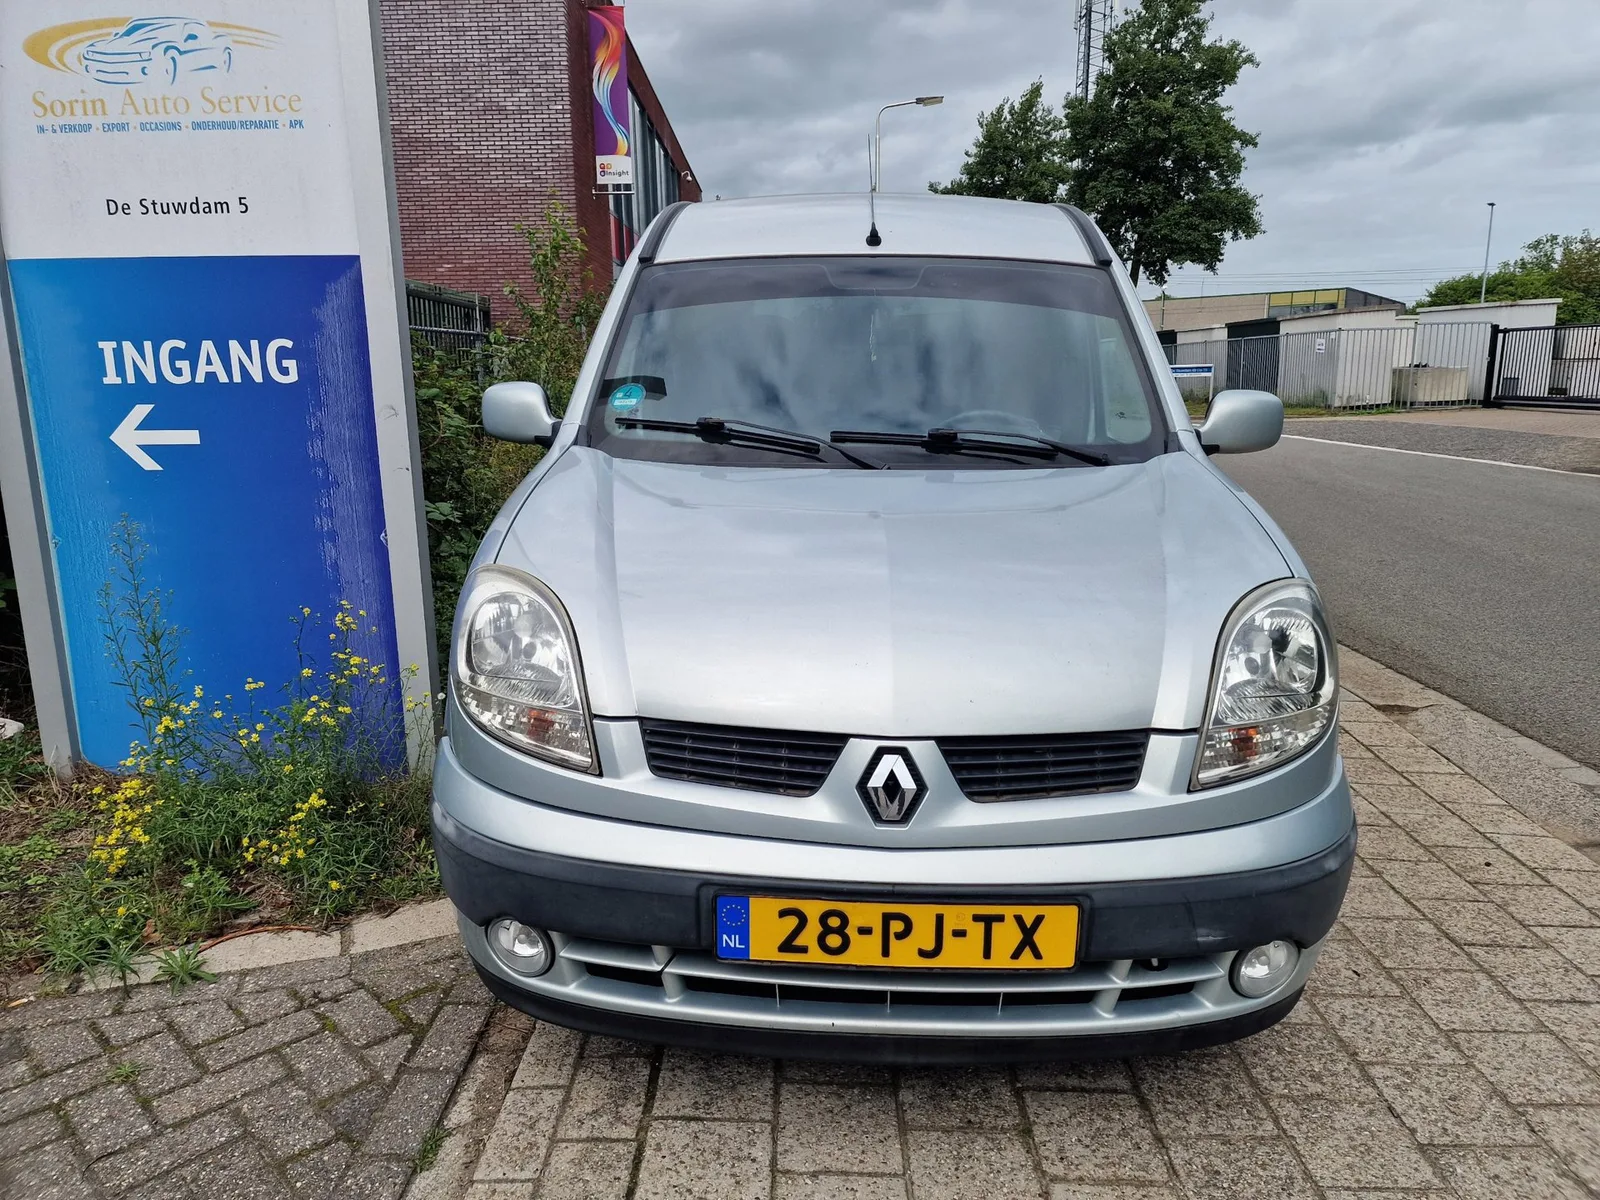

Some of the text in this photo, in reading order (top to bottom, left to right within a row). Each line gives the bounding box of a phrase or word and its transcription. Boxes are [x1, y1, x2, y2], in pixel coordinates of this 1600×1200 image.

[32, 86, 303, 118] Sorin Auto Service
[36, 119, 304, 134] IN- & VERKOOP EXPORT OCCASIONS ONDERHOUD/REPARATIE APK
[106, 196, 249, 216] De Stuwdam 5
[98, 338, 299, 385] INGANG
[722, 933, 745, 949] NL
[777, 906, 1045, 961] 28-PJ-TX
